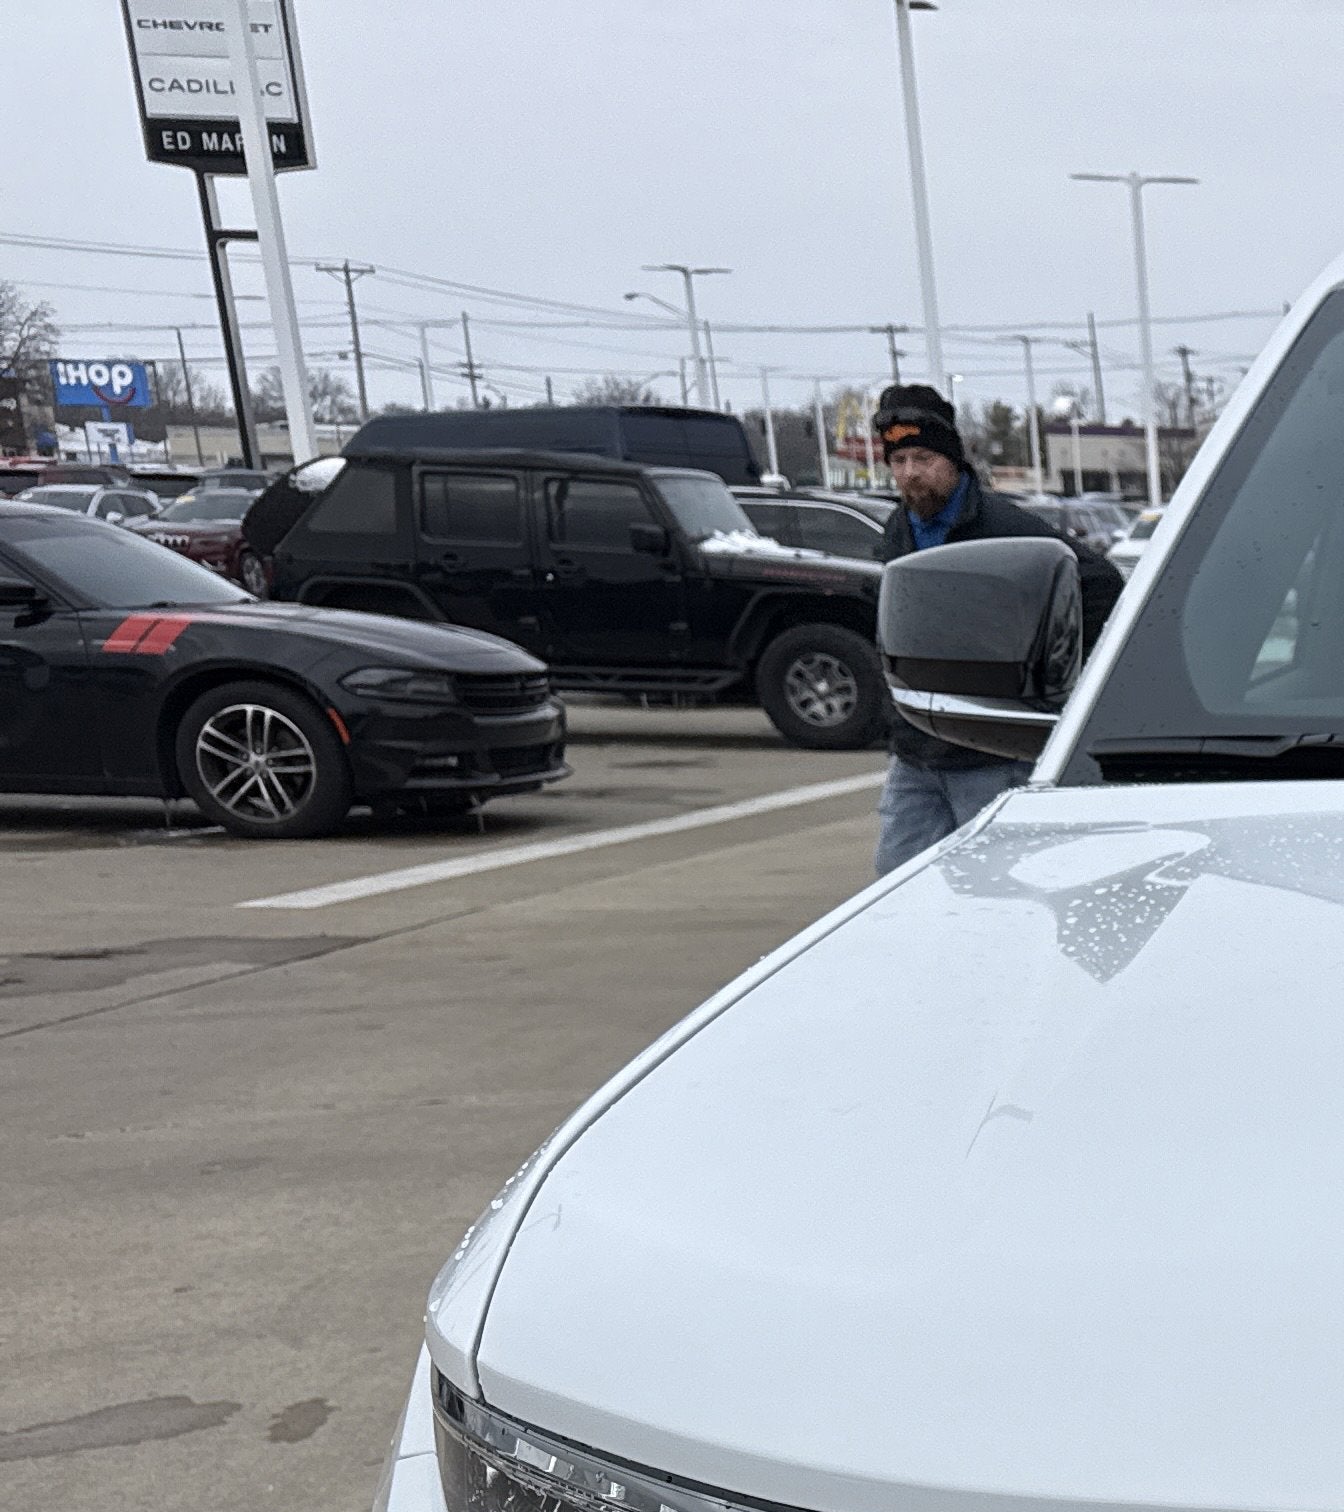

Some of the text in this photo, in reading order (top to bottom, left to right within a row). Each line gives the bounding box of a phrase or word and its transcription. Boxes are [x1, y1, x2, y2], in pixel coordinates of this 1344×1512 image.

[136, 18, 273, 34] CHEVROET
[148, 77, 283, 97] CADILC
[161, 130, 287, 155] ED MARN
